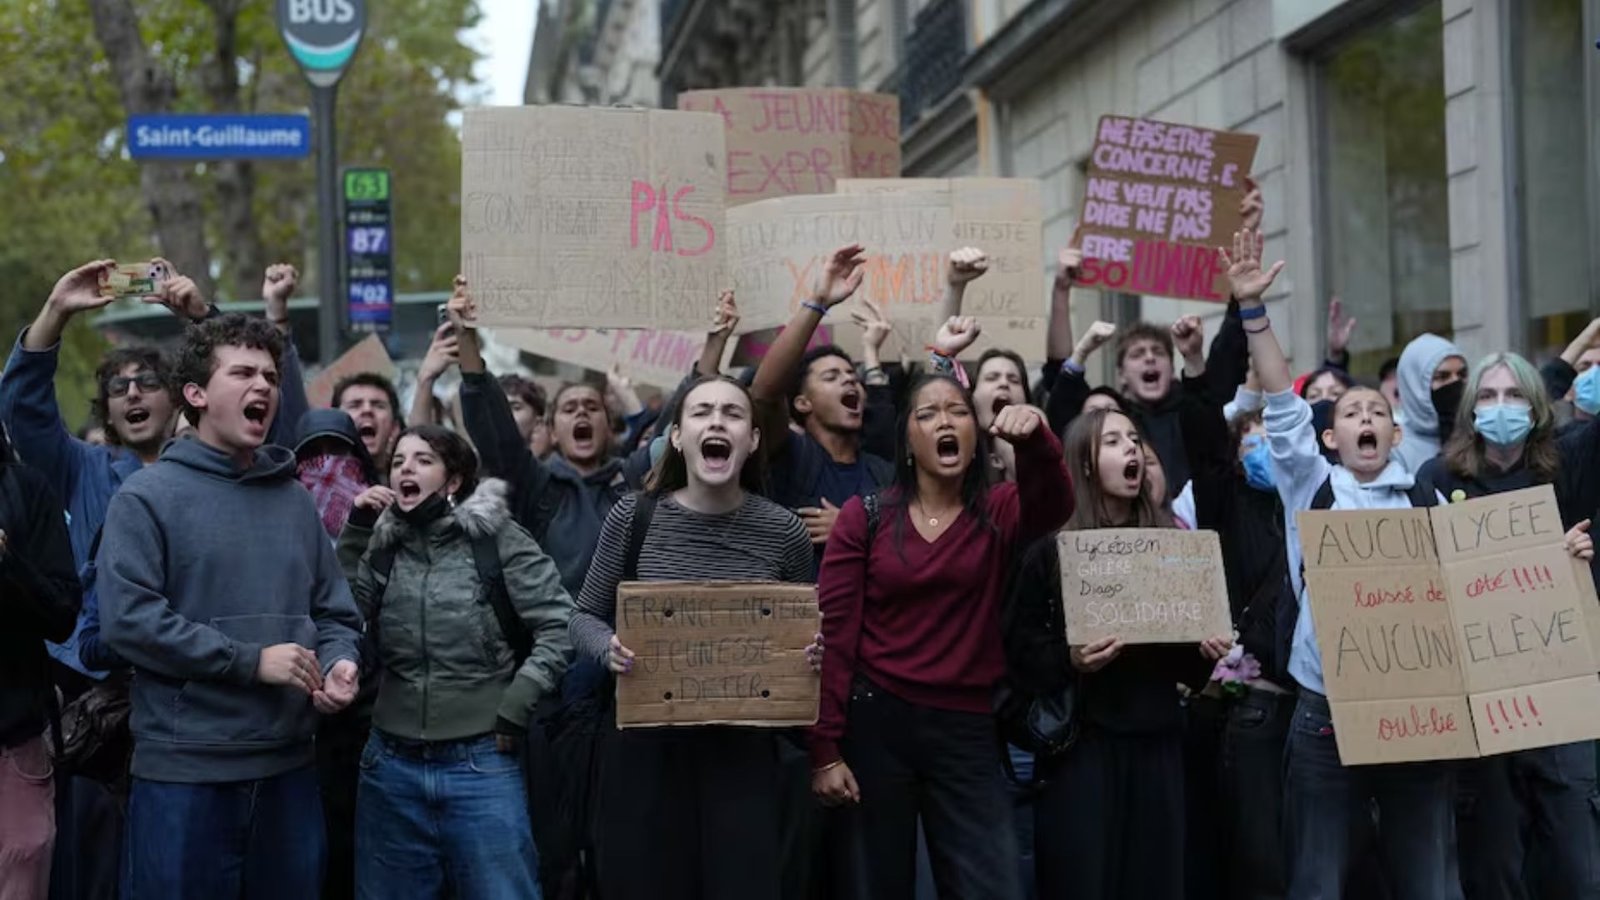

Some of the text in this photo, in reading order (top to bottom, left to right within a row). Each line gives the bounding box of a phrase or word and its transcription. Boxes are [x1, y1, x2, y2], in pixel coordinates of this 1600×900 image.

[290, 0, 354, 22] BUS
[136, 124, 302, 147] Saint-Guillaume
[1101, 118, 1131, 144] NE
[1131, 120, 1165, 148] PAS
[1087, 178, 1213, 215] NE VEUT PAS
[629, 179, 716, 257] PAS
[1084, 200, 1213, 242] DIRE NE PAS
[352, 227, 385, 253] 87
[1081, 234, 1134, 262] ETRE
[1316, 500, 1554, 566] AUCUN LYCÉE
[1426, 579, 1446, 602] de
[1085, 599, 1204, 628] SOLIDAIRE
[642, 636, 772, 674] JEUNESSE
[1337, 622, 1454, 678] AUCUN
[1485, 694, 1544, 735] !!!!
